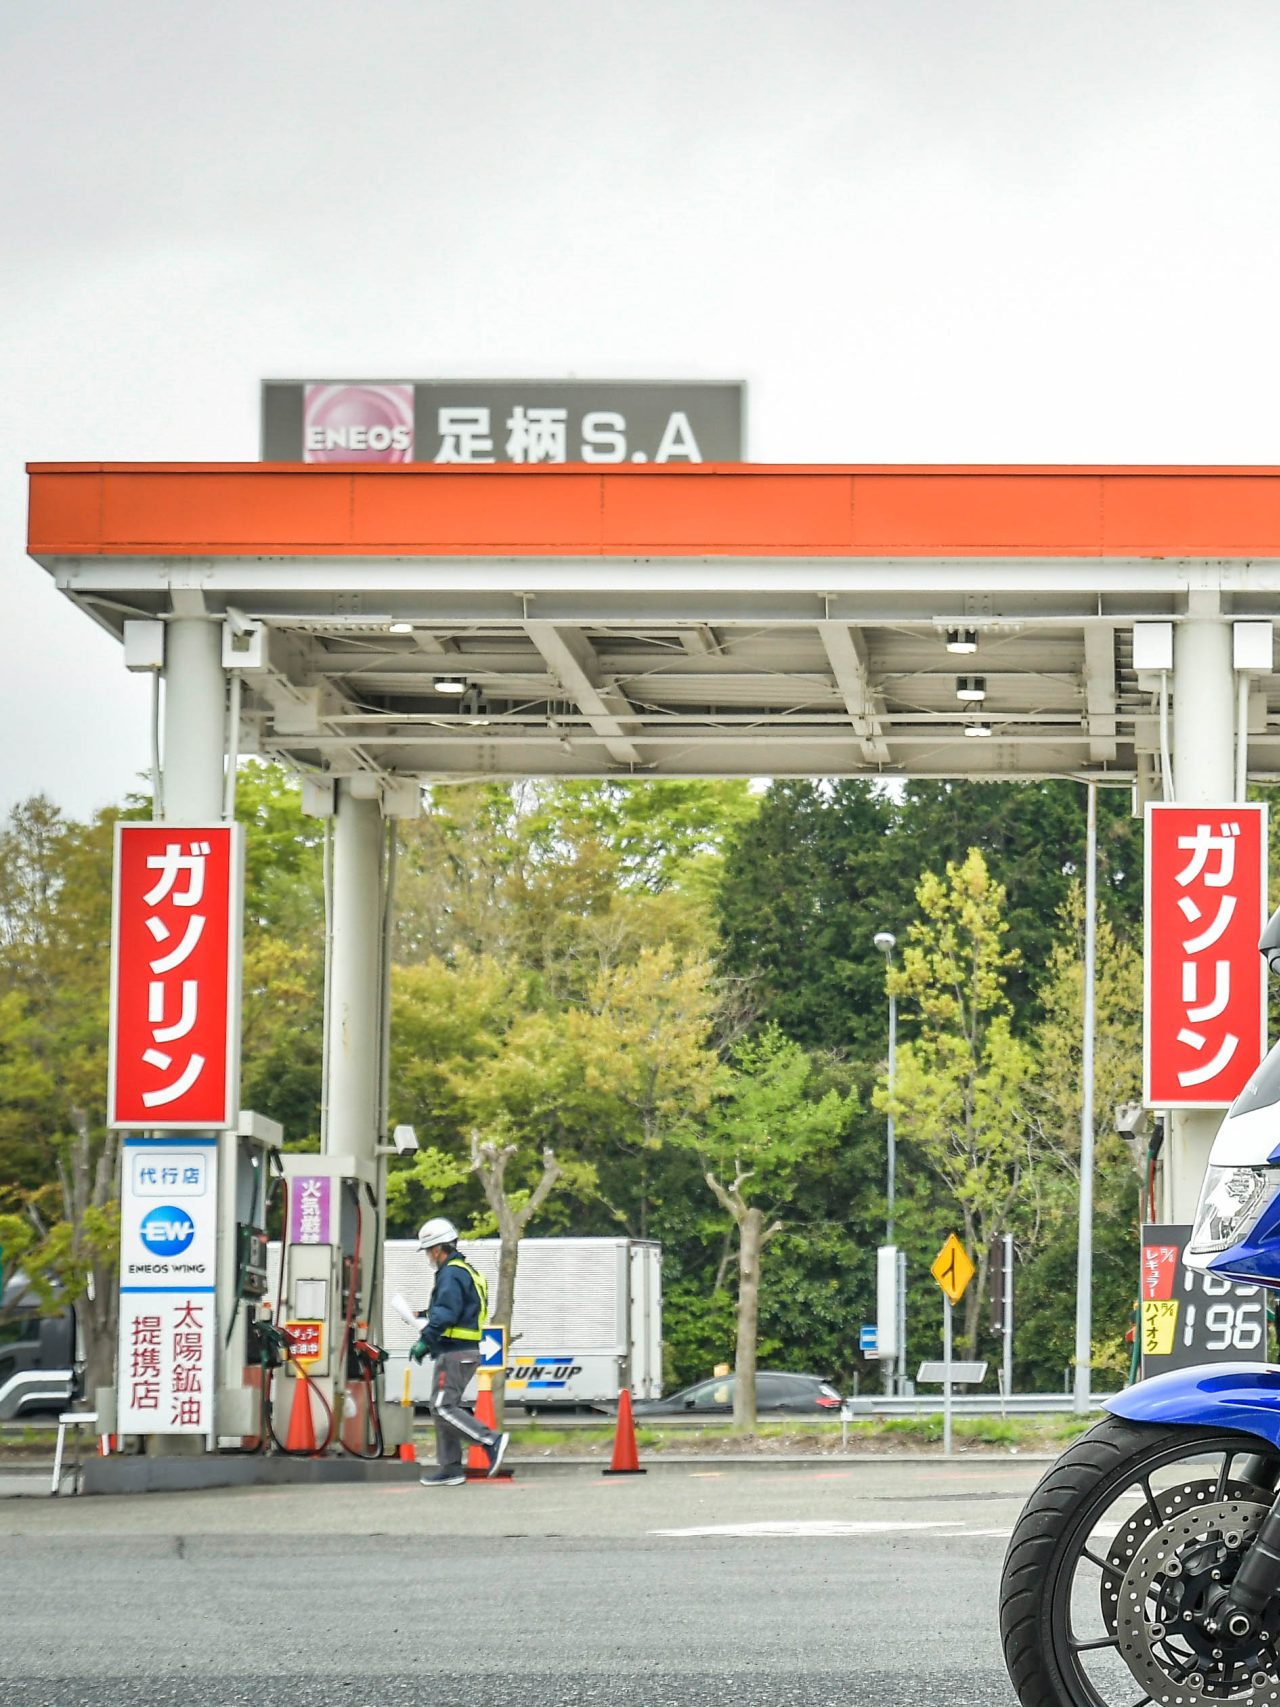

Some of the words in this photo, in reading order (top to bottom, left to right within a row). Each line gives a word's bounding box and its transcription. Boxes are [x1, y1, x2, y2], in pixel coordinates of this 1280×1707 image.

[307, 425, 411, 451] ENEOS
[142, 842, 211, 1108] ガソリン
[1174, 822, 1240, 1088] ガソリン
[140, 1168, 200, 1185] 代行店
[145, 1221, 191, 1242] EW
[128, 1264, 169, 1274] ENEOS
[172, 1264, 206, 1274] WING
[1146, 1303, 1160, 1353] ハイオク
[1183, 1302, 1262, 1351] 196
[130, 1315, 162, 1410] 提携店
[170, 1300, 204, 1427] 太陽鉱油
